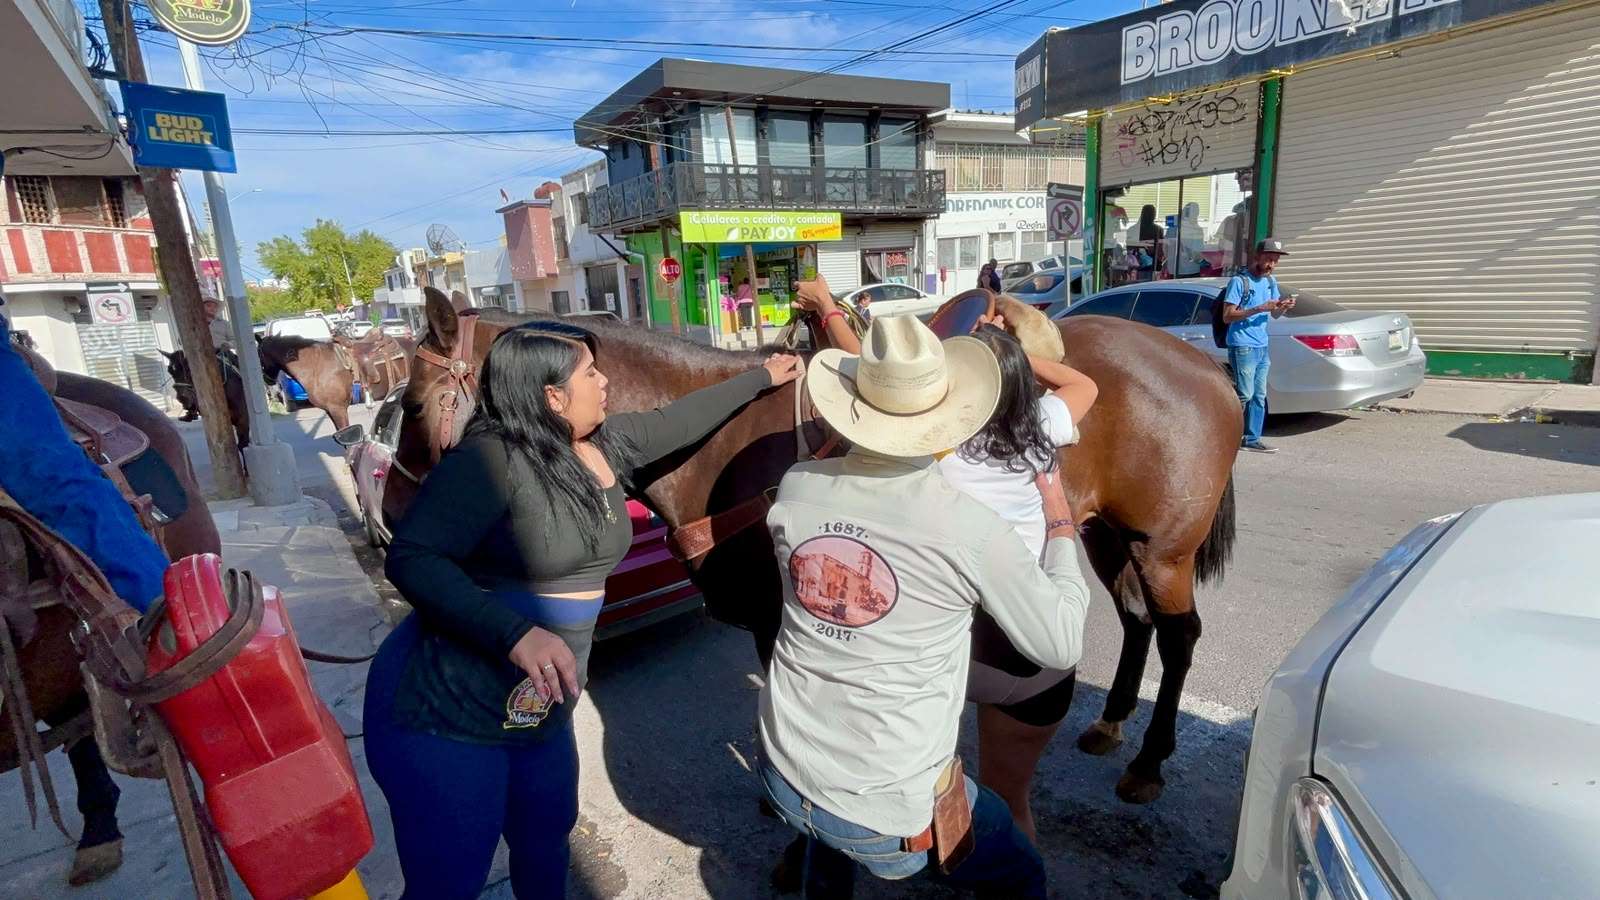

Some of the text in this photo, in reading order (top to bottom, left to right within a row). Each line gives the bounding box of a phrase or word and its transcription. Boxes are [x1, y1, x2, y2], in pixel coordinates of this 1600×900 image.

[178, 6, 223, 23] Modelo
[1121, 0, 1458, 85] BROOK
[155, 112, 204, 130] BUD
[148, 126, 213, 145] LIGHT
[1015, 196, 1045, 209] COR
[1016, 220, 1046, 231] Regina
[741, 226, 796, 240] PAYJOY
[661, 265, 680, 274] ALTO
[511, 712, 540, 723] Modelo
